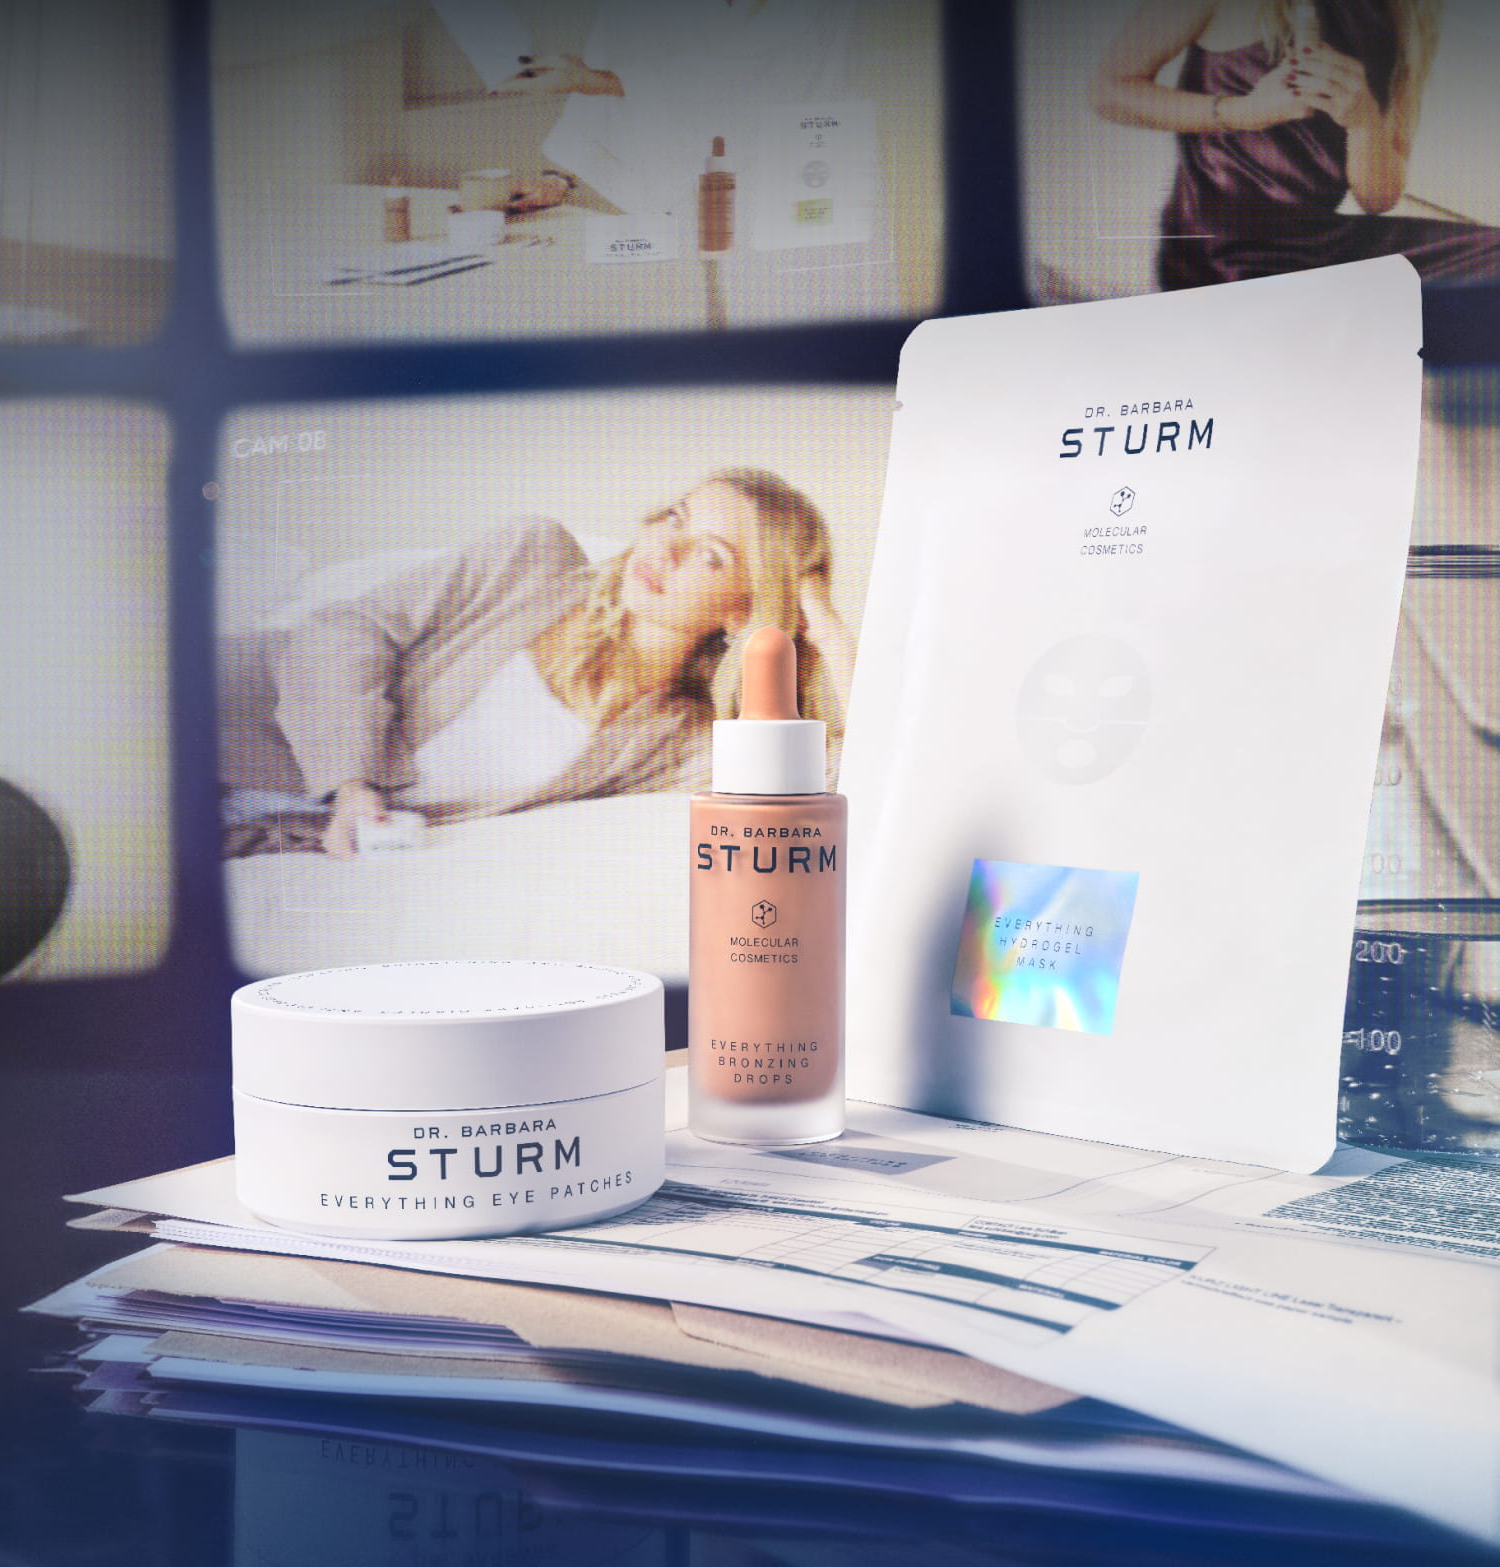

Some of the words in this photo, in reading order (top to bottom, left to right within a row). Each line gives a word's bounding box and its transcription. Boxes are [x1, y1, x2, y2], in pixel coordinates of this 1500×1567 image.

[1084, 406, 1111, 419] DR.
[1120, 398, 1194, 416] BARBARA
[235, 436, 288, 458] CAM
[1059, 417, 1214, 459] STURM
[1083, 525, 1148, 538] MOLECULAR
[1080, 543, 1144, 556] COSMETICS
[710, 825, 735, 838] DR.
[743, 827, 822, 838] BARBARA
[697, 843, 837, 873] STURM
[994, 917, 1094, 937] EVERYTHING
[730, 936, 799, 948] MOLECULAR
[1000, 936, 1081, 955] HYDROGEL
[730, 952, 798, 964] COSMETICS
[1355, 939, 1404, 965] 200
[1016, 956, 1057, 970] MASK
[711, 1040, 818, 1052] EVERYTHING
[718, 1056, 809, 1069] BRONZING
[733, 1073, 793, 1084] DROPS
[413, 1127, 449, 1139] DR.
[461, 1118, 557, 1138] BARBARA
[387, 1136, 581, 1181] STURM
[320, 1193, 475, 1210] EVERYTHING
[492, 1189, 535, 1206] EYE
[550, 1170, 633, 1200] PATCHES
